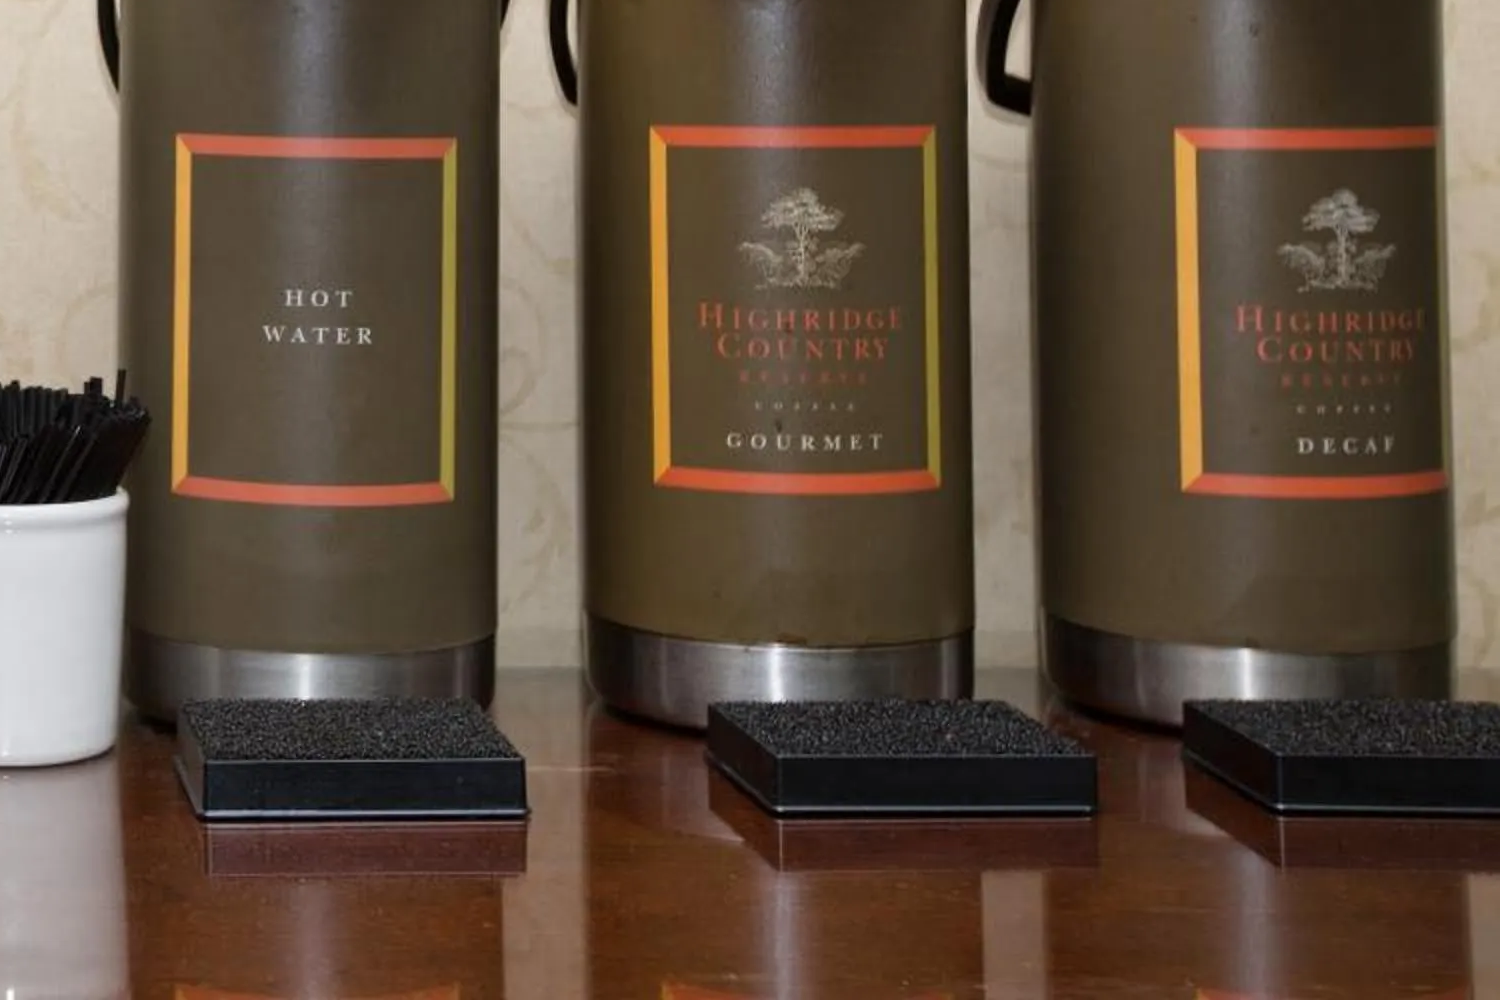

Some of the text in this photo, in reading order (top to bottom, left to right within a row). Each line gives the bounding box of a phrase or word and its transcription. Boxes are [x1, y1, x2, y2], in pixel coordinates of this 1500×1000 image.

[285, 289, 353, 308] HOT
[698, 302, 900, 330] HIGHRIDGE
[262, 325, 372, 345] WATER
[716, 333, 888, 360] COUNTRY
[727, 432, 883, 451] GOURMET
[1298, 436, 1394, 454] DECAF
